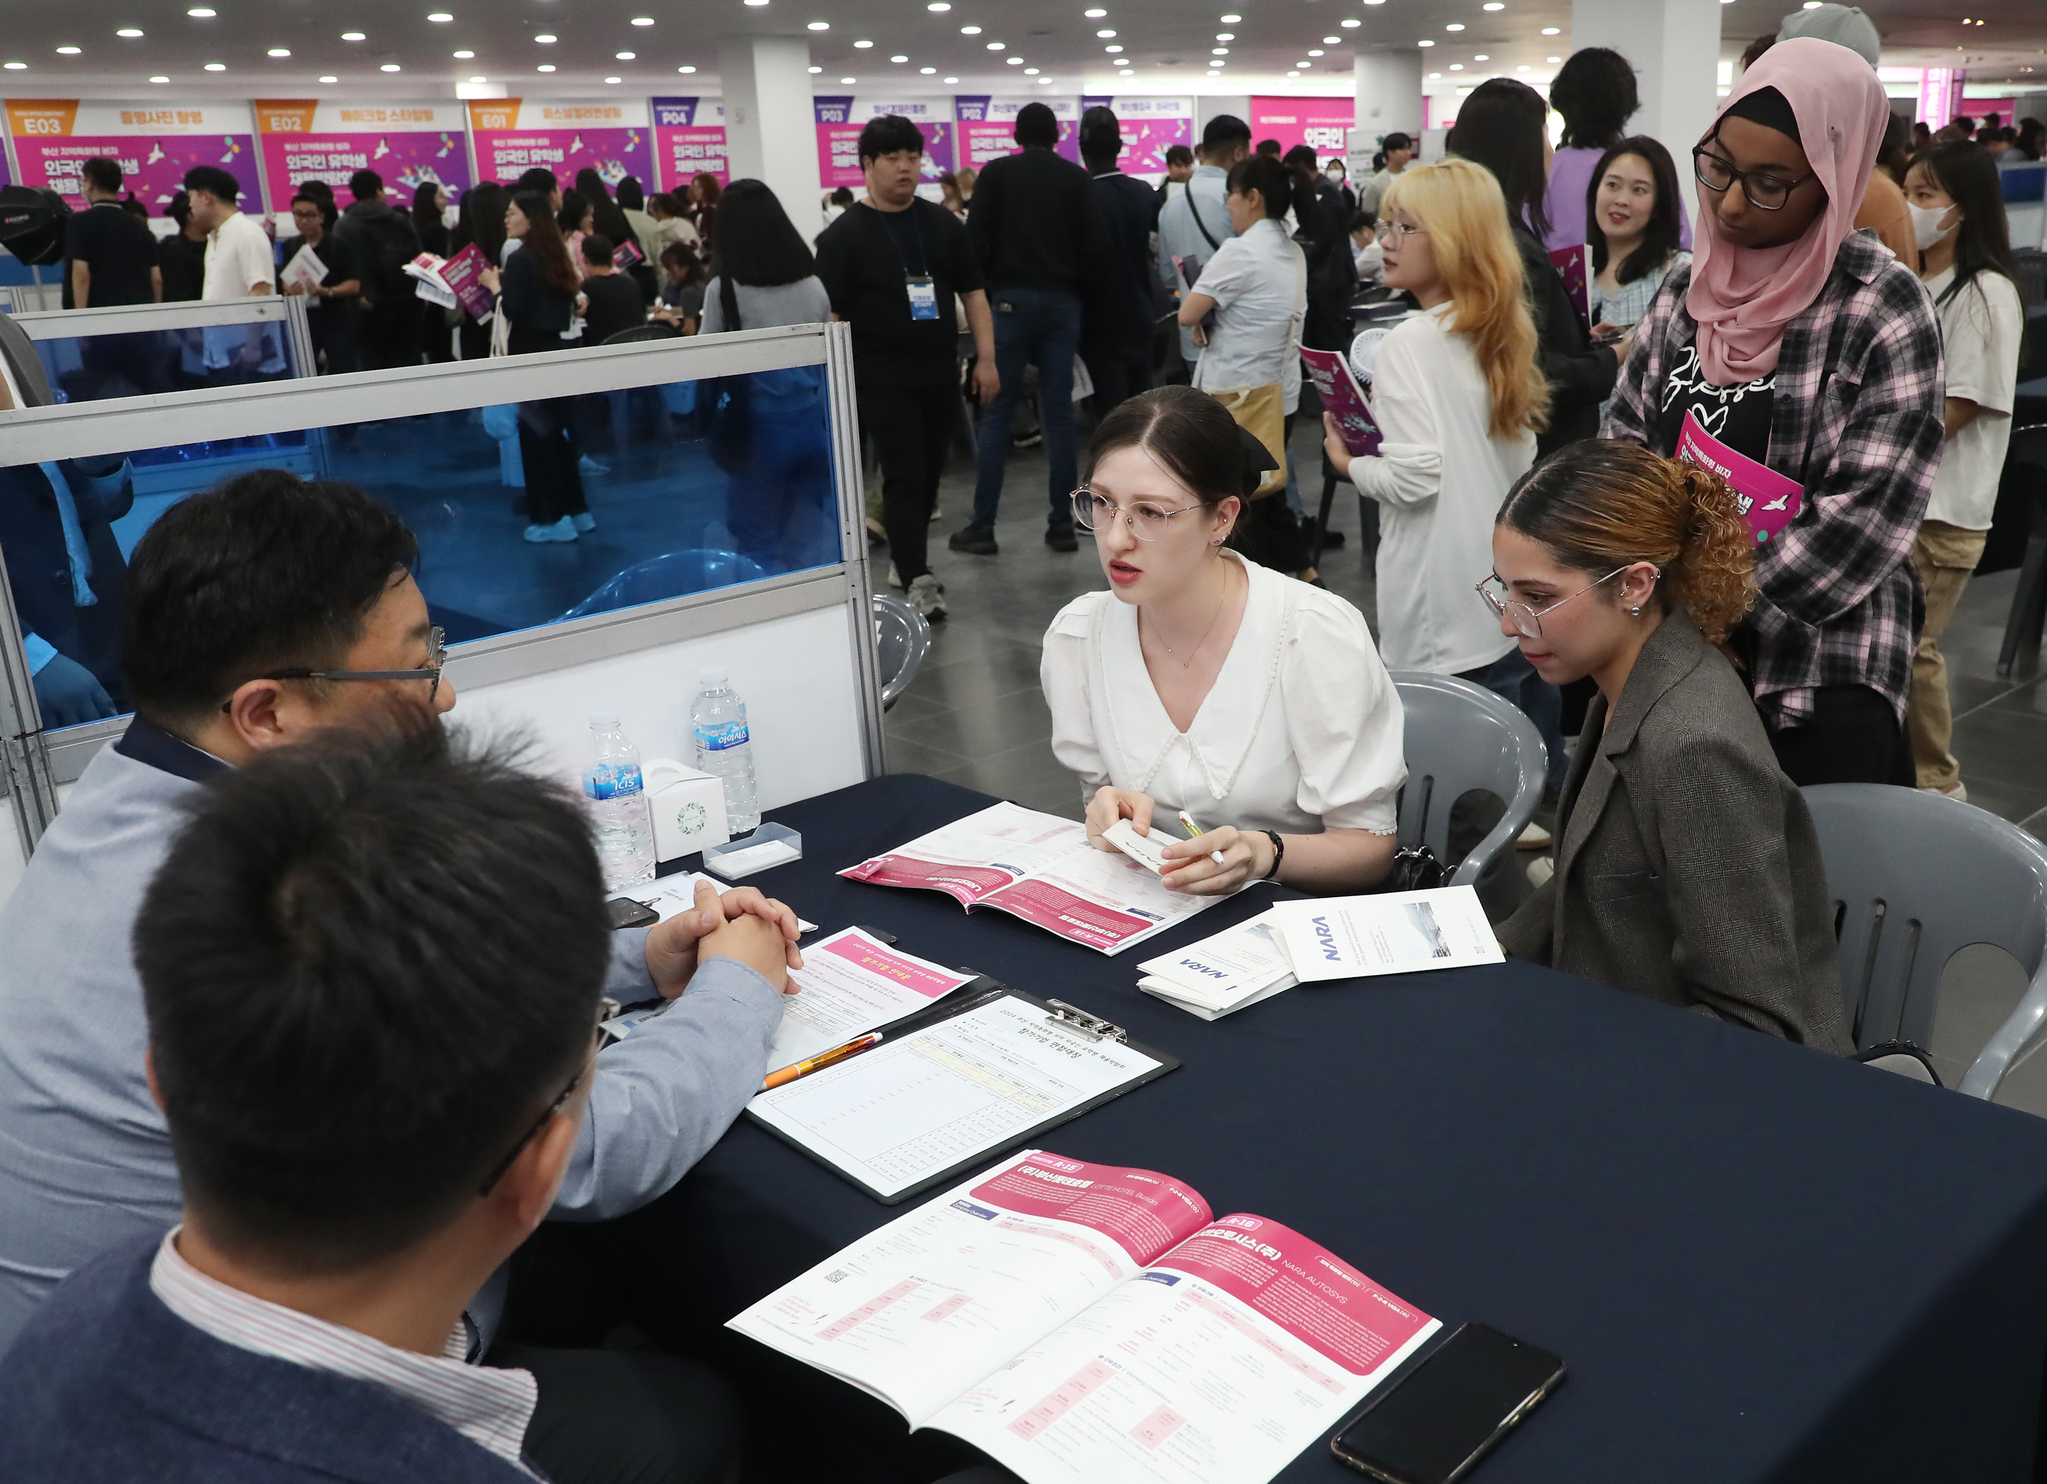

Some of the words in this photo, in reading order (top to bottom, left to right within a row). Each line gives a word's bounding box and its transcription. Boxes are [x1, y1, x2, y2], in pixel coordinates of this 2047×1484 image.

[482, 114, 507, 128] E01
[662, 111, 687, 125] P04
[821, 110, 844, 122] P03
[962, 108, 982, 120] P02
[24, 118, 61, 134] E03
[270, 117, 303, 131] E02
[1303, 127, 1345, 150] 외국인
[286, 154, 327, 170] 외국인
[328, 153, 369, 169] 유학생
[494, 150, 529, 165] 외국인
[1715, 463, 1732, 479] 비자
[1311, 916, 1341, 962] NARA
[1179, 958, 1230, 979] NARA
[1018, 1027, 1051, 1044] 참가기업
[1049, 1041, 1083, 1059] 면접대장
[1090, 1183, 1113, 1192] LOTTE
[1112, 1185, 1136, 1197] HOTEL
[1135, 1192, 1159, 1206] Busan
[1227, 1218, 1256, 1228] A-16
[1281, 1259, 1306, 1278] NARA
[1305, 1275, 1349, 1305] AUTOSYS
[779, 1300, 800, 1314] Students
[785, 1297, 816, 1315] International
[1218, 1294, 1229, 1305] Job
[1387, 1302, 1401, 1314] VISA
